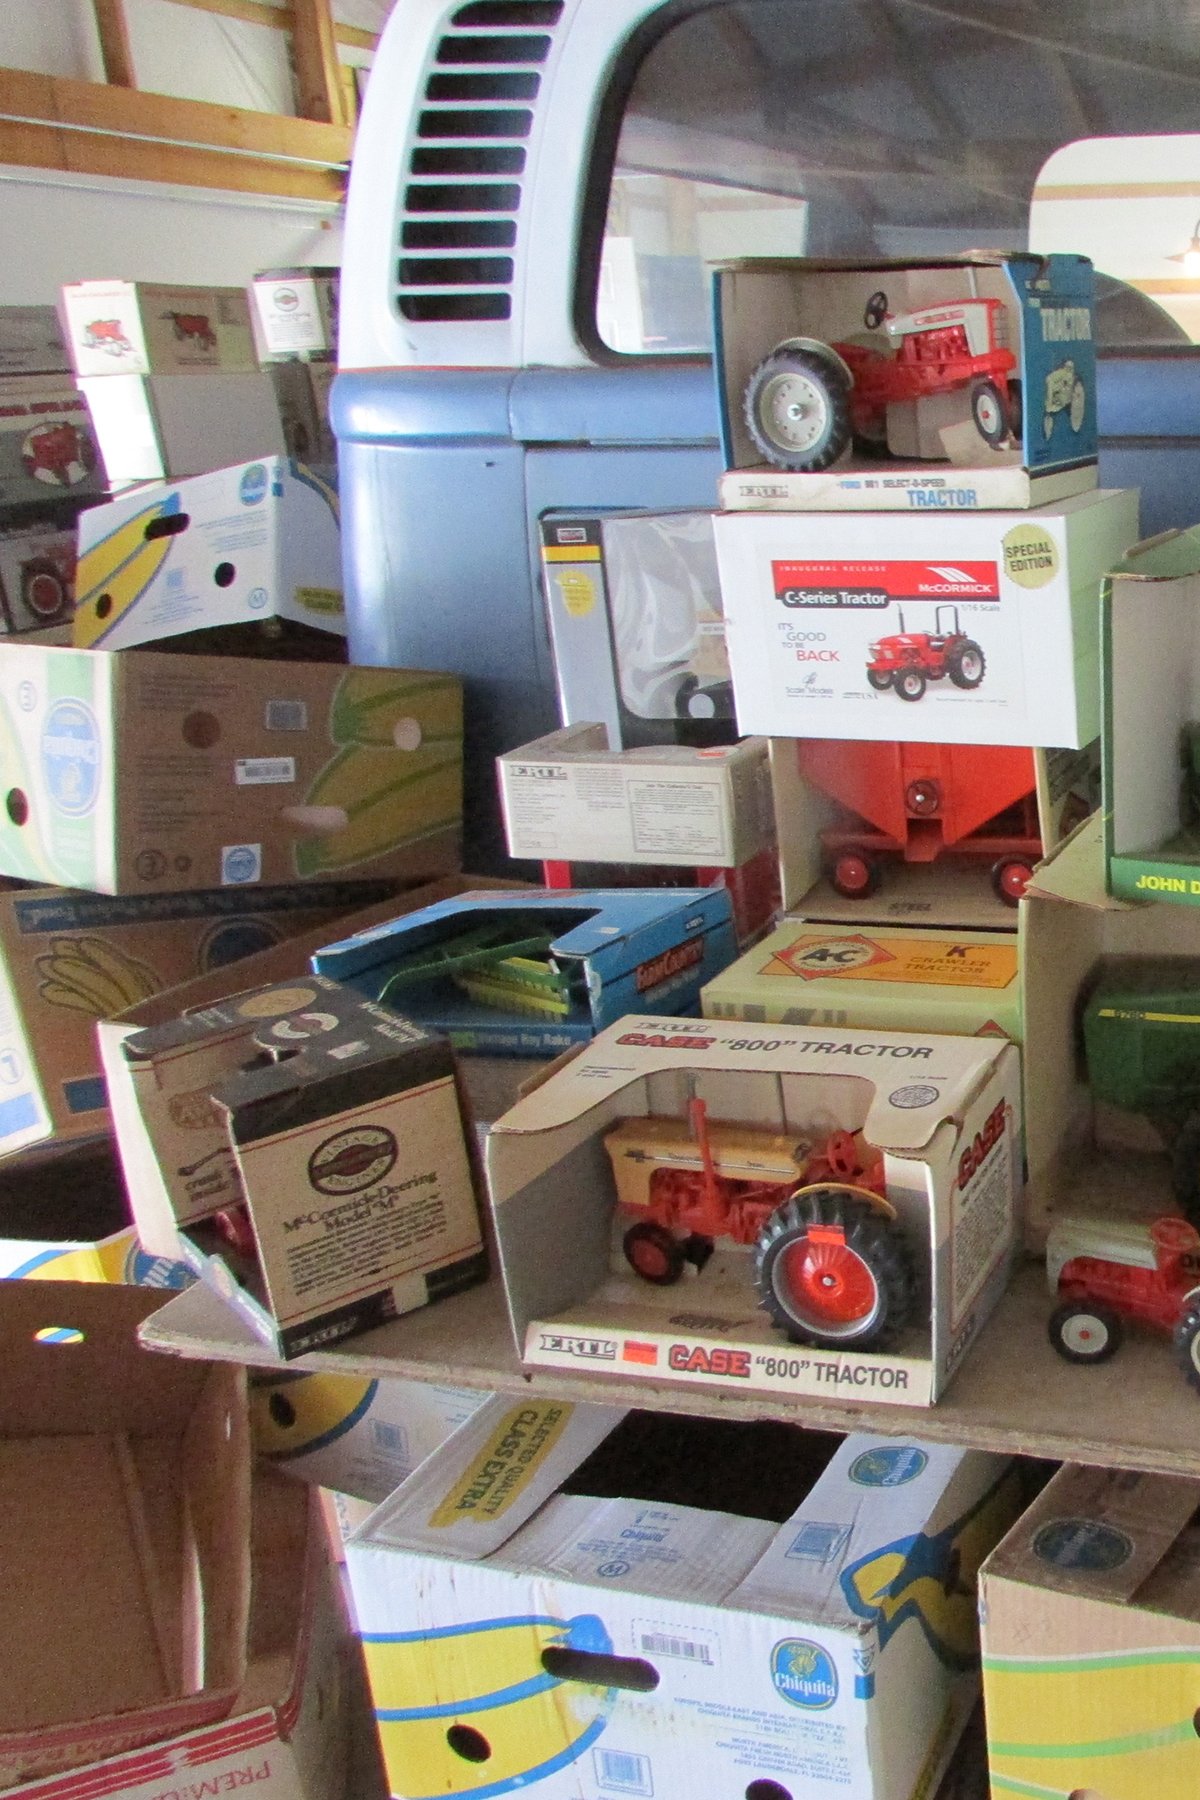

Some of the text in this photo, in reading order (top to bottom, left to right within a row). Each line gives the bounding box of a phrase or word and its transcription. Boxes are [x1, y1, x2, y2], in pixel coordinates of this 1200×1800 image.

[907, 489, 978, 507] TRACTOR
[1006, 542, 1053, 558] SPECIAL
[1010, 556, 1054, 572] EDITION
[918, 583, 993, 593] McCORMICK
[785, 590, 887, 606] C-Series Tractor
[782, 641, 805, 650] TO BE
[786, 631, 827, 642] GOOD
[796, 649, 841, 662] BACK
[1136, 875, 1186, 893] JOHN
[904, 963, 985, 974] TRACTOR
[616, 1032, 935, 1059] CASE “800” TRACTOR
[958, 1096, 1005, 1191] CASE
[325, 1204, 373, 1232] Model
[538, 1334, 615, 1360] ERTL
[668, 1343, 908, 1389] CASE “800” TRACTOR
[455, 1409, 538, 1510] CLASS EXTRA
[483, 1407, 563, 1516] SELECTED QUALITY
[774, 1672, 836, 1697] Chiquita
